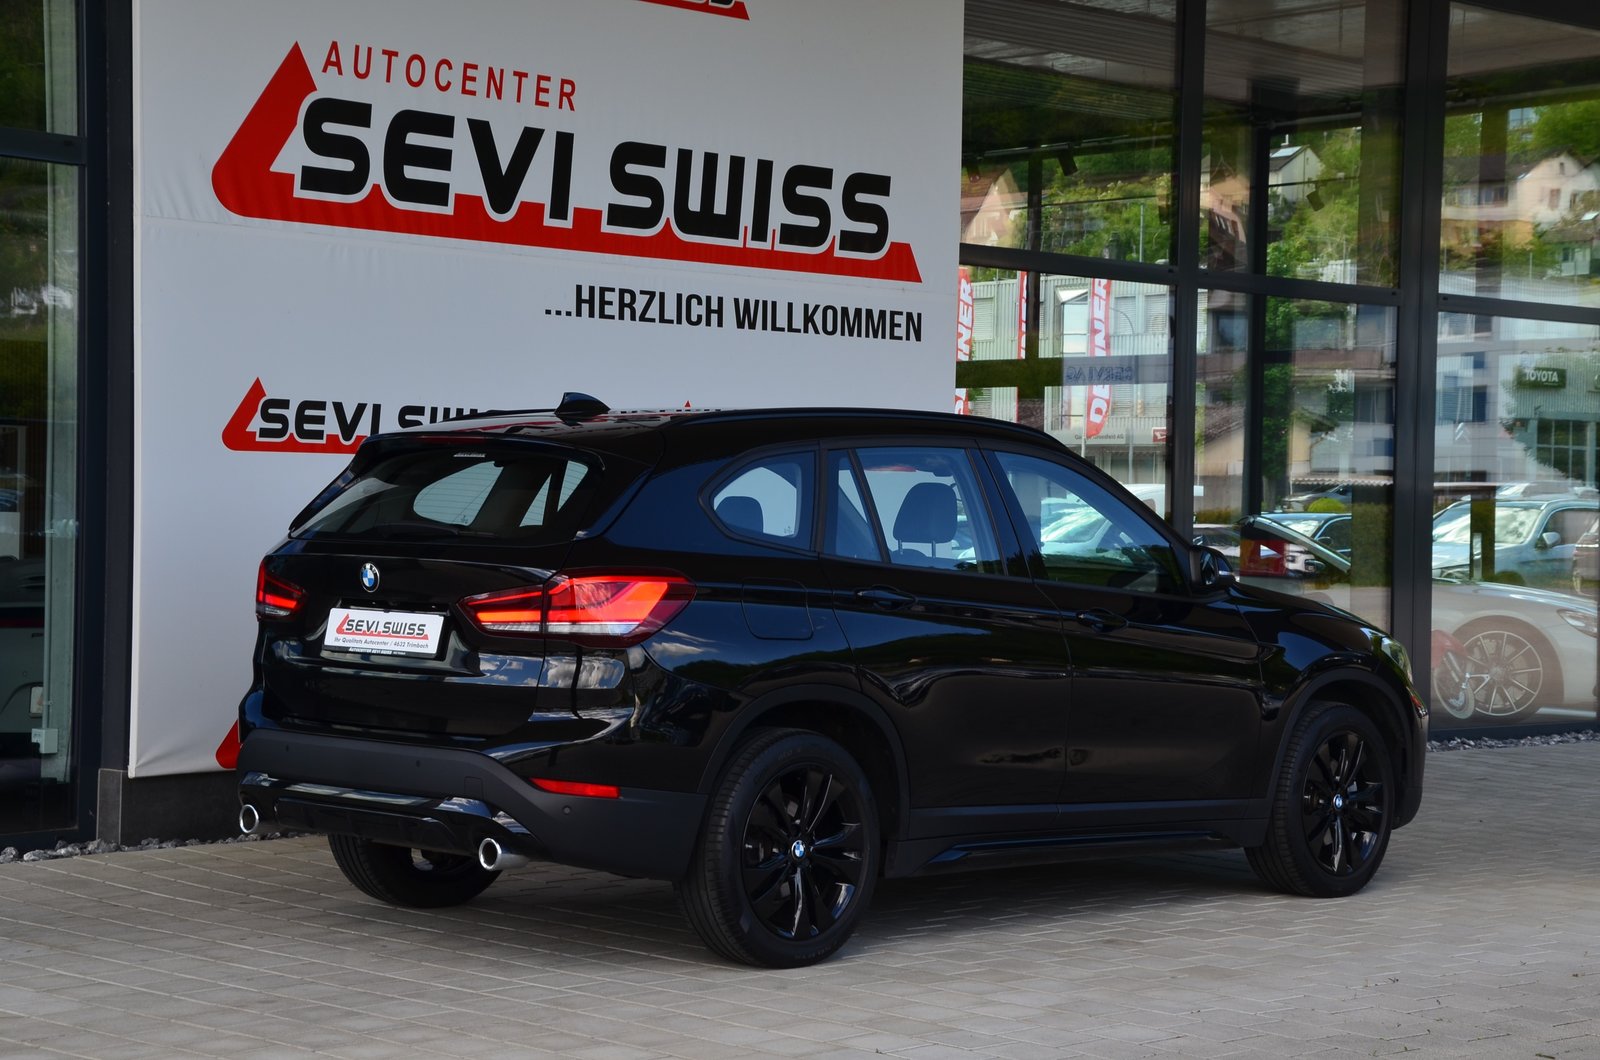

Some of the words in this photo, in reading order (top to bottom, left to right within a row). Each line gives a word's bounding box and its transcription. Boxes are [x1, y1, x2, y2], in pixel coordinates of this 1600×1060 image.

[322, 40, 577, 111] AUTOCENTER
[299, 97, 575, 221] SEVI
[606, 141, 891, 254] SWISS
[733, 297, 922, 342] WILLKOMMEN
[1525, 369, 1559, 382] TOYOTA
[258, 398, 382, 442] SEVI
[345, 619, 380, 633] SEVI
[382, 621, 426, 636] SWISS
[406, 641, 429, 649] Trimbach
